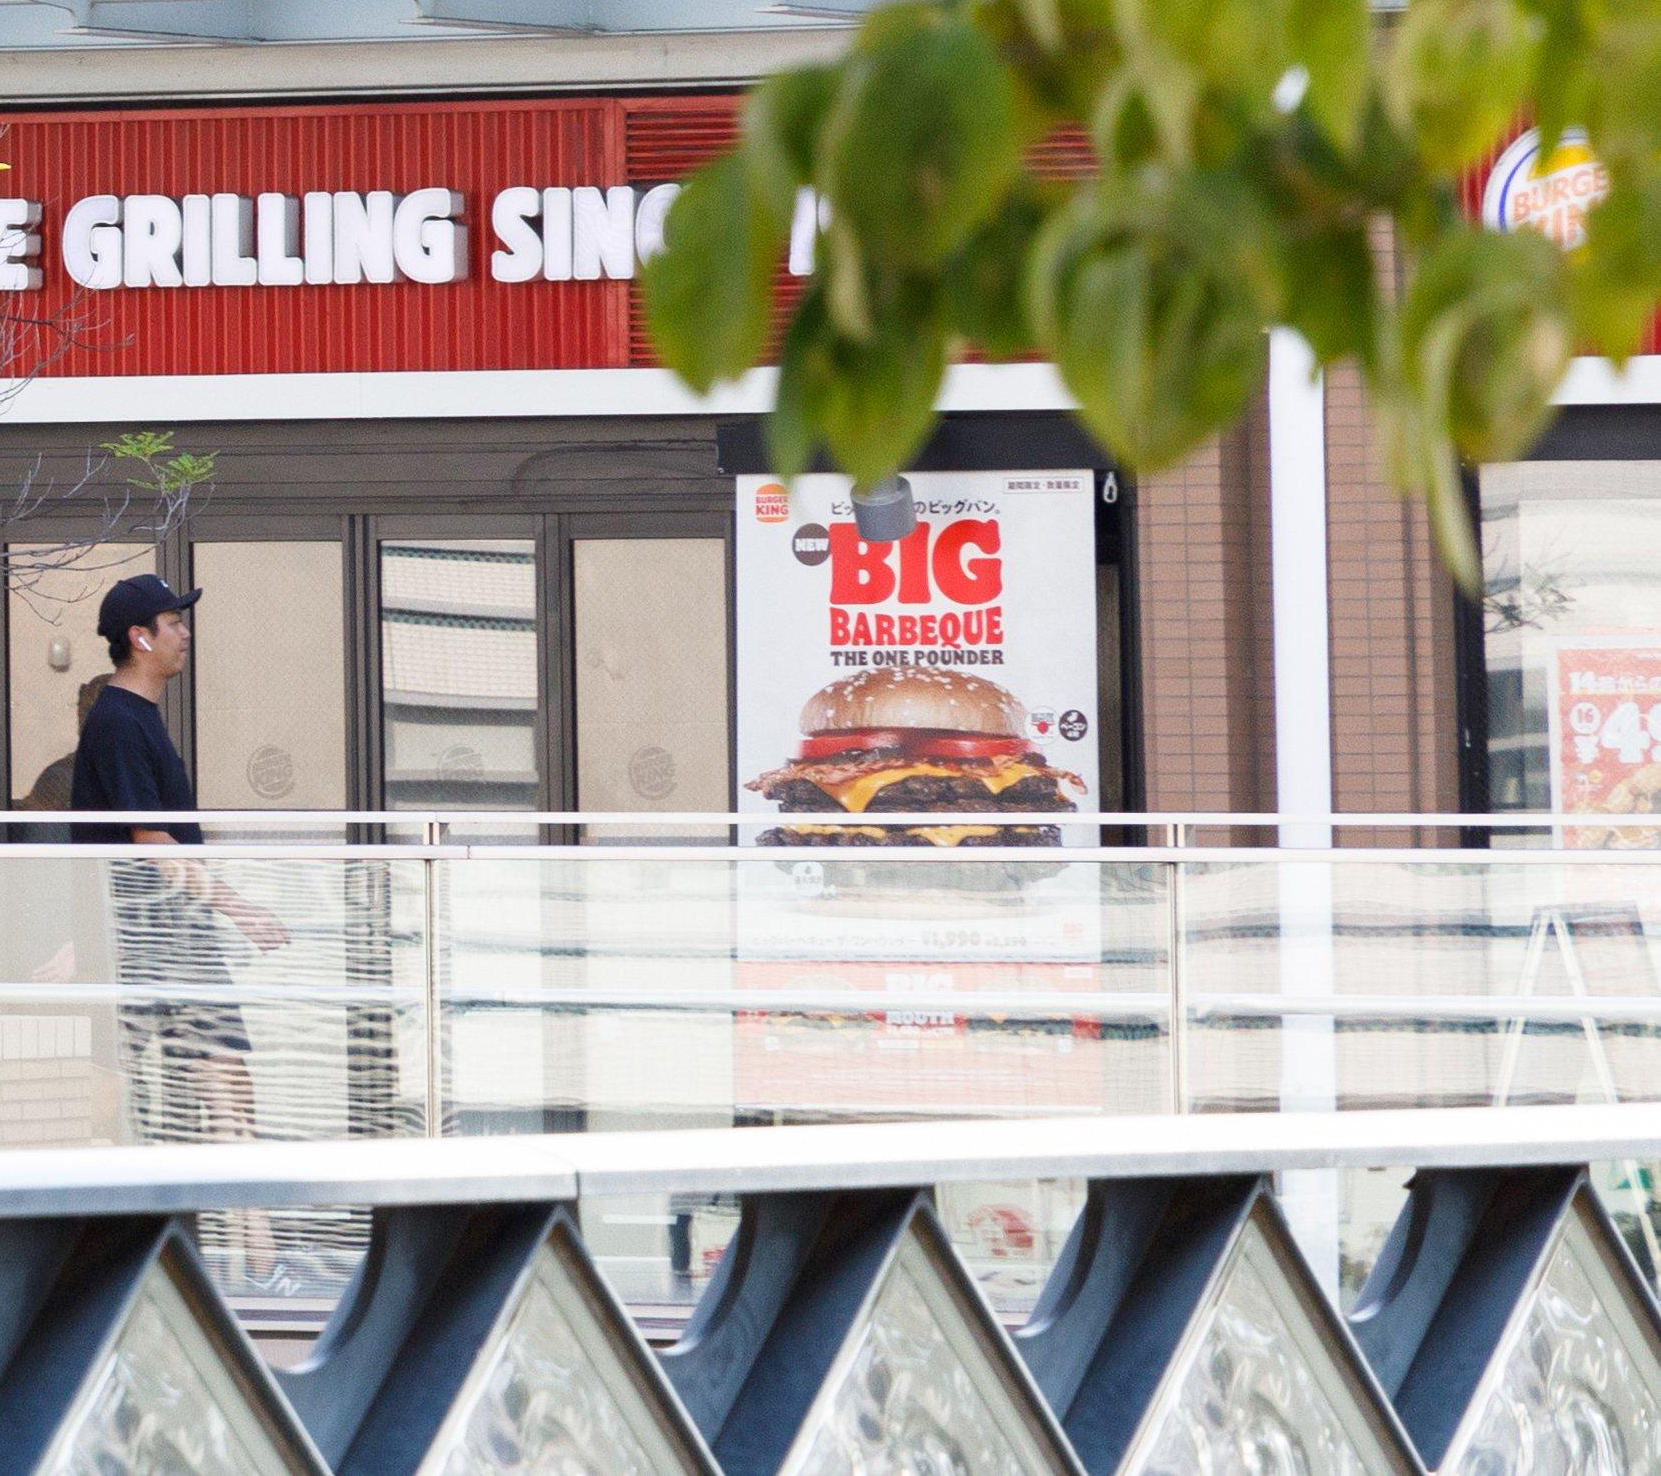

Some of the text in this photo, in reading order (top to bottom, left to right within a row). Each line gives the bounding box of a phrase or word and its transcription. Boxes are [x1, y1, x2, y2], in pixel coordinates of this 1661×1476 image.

[1513, 165, 1607, 222] BURGE
[63, 186, 464, 290] GRILLING
[755, 504, 789, 516] KING
[795, 538, 829, 552] NEW
[829, 519, 1003, 605] BIG
[829, 606, 1004, 649] BARBEQUE
[830, 649, 1005, 666] THE ONE POUNDER
